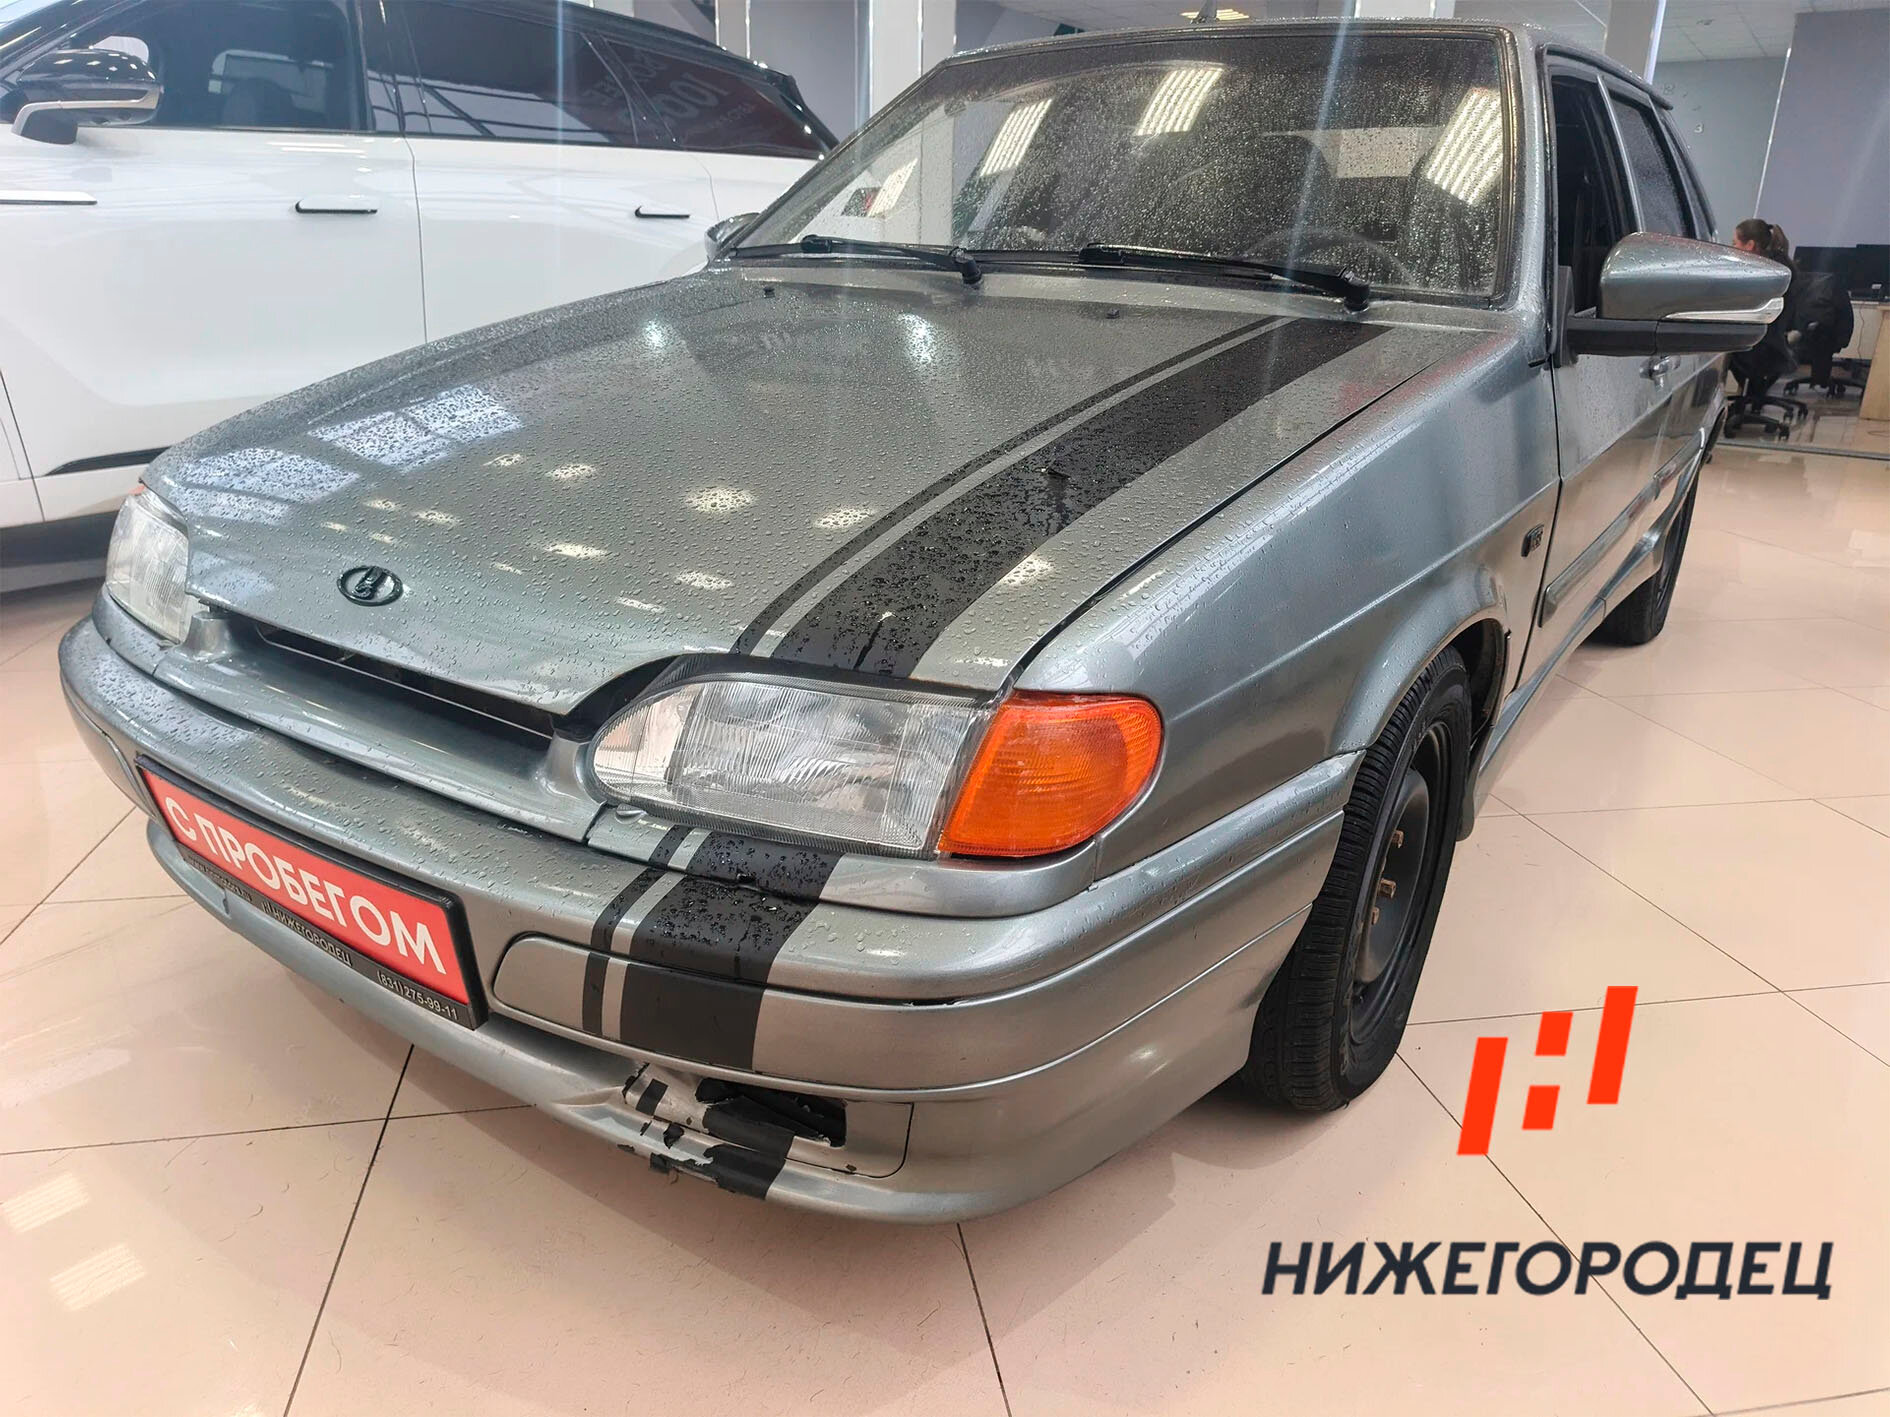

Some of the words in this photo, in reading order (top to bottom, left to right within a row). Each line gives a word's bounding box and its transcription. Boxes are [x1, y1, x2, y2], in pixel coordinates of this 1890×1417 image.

[165, 797, 197, 841] С
[194, 814, 447, 974] ПРОБЕГОМ
[273, 909, 353, 967] НИЖЕГОРОДЕЦ
